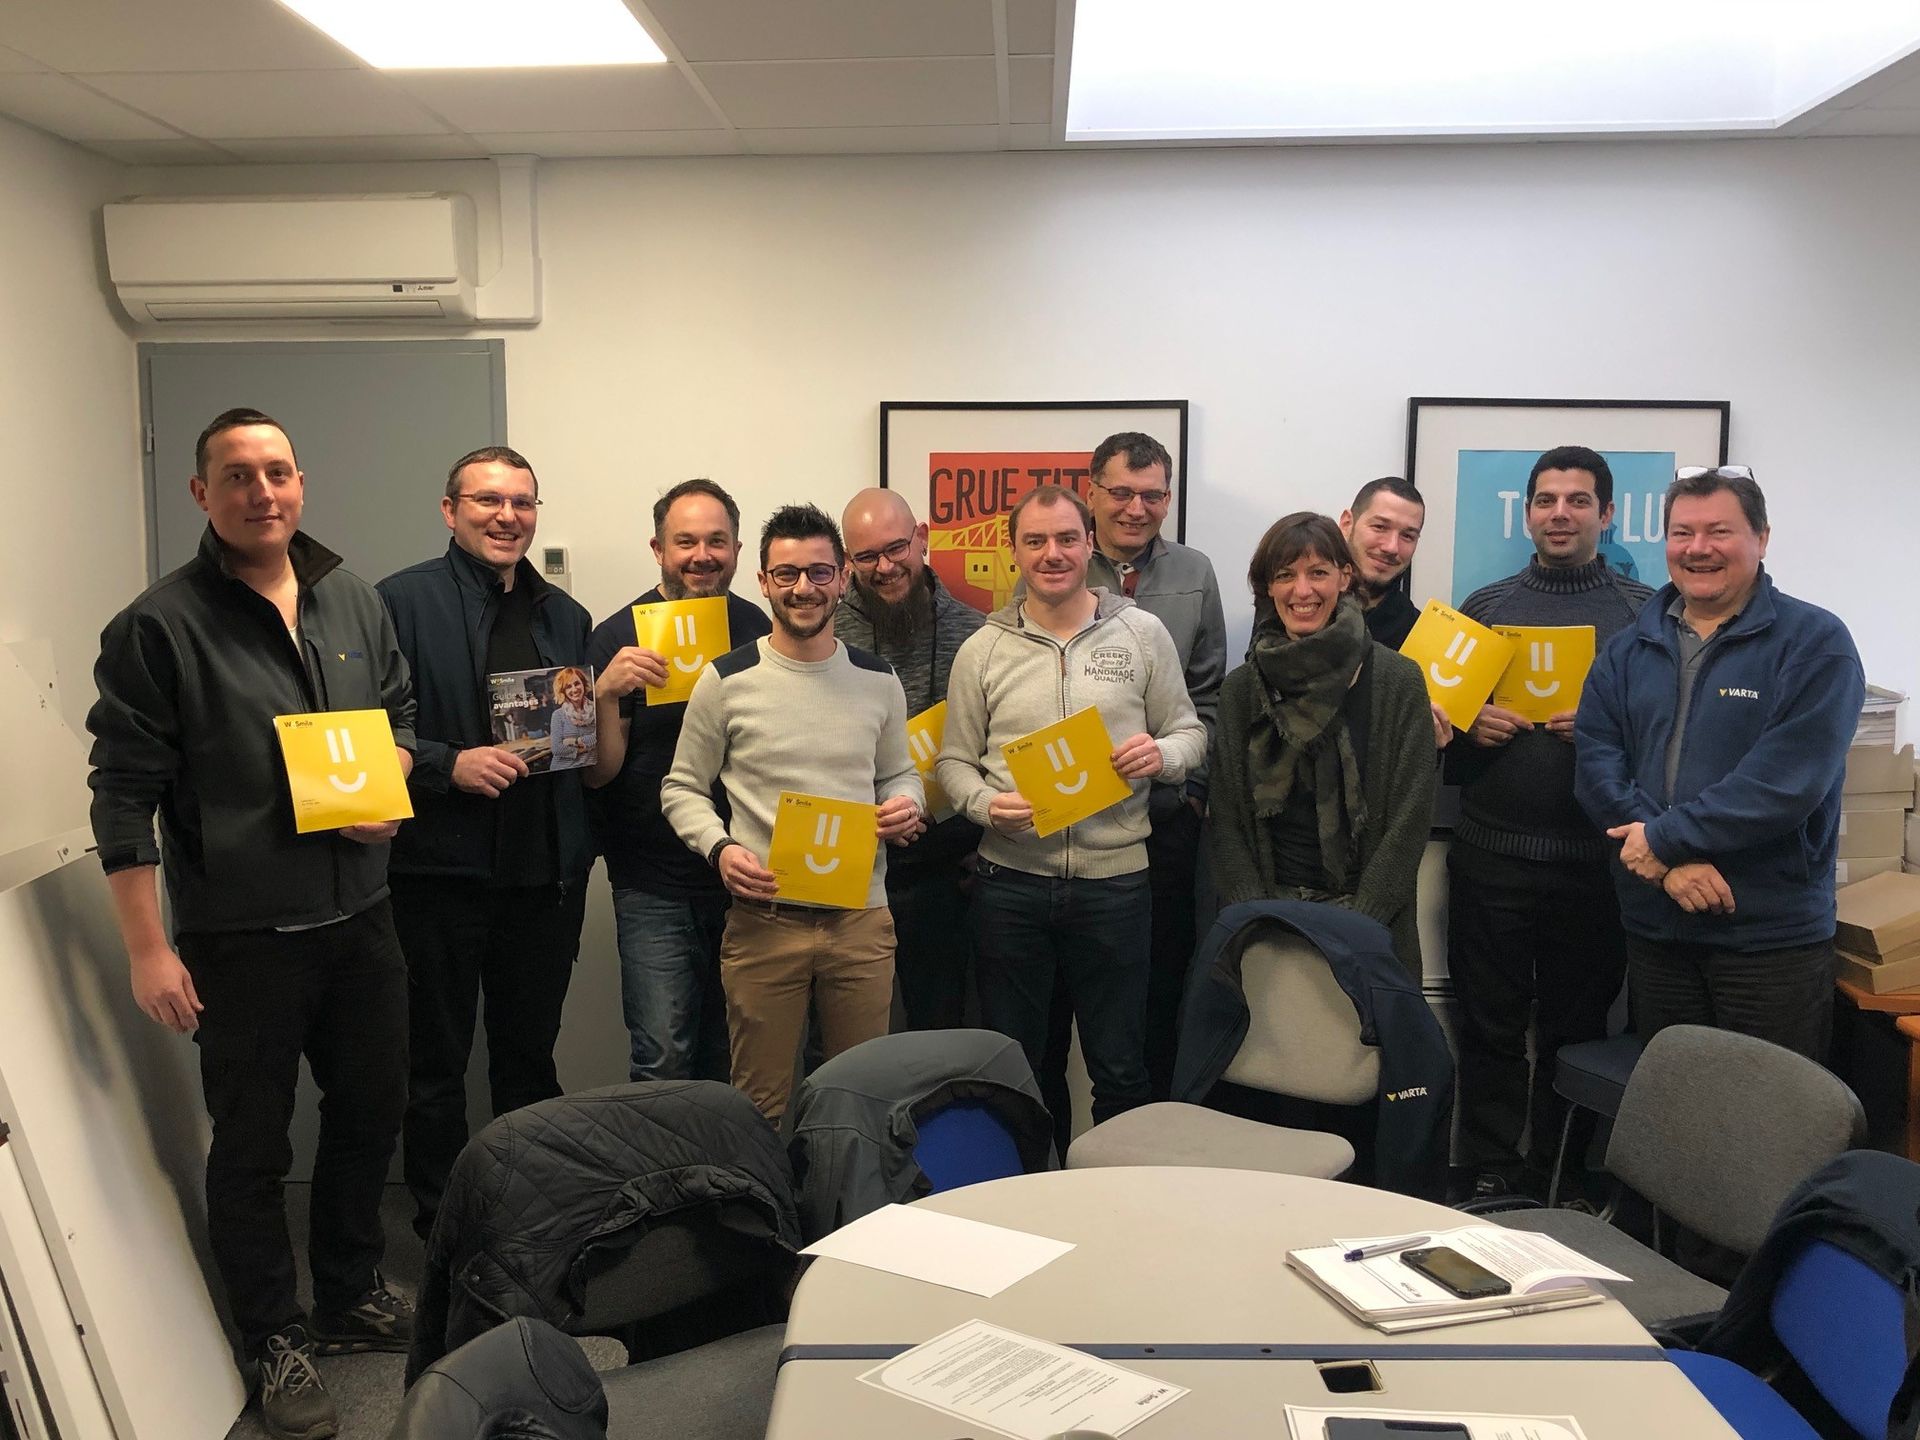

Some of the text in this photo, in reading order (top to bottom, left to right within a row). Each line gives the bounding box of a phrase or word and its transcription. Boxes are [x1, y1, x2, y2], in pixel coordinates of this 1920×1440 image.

[930, 468, 1019, 524] GRUE
[1623, 493, 1665, 543] LU
[1093, 652, 1130, 661] CREEKS
[1084, 664, 1135, 682] HANDMADE
[1093, 675, 1127, 685] QUALITY
[1728, 687, 1760, 700] VARTA
[493, 698, 539, 710] avantages
[1397, 1086, 1428, 1100] VARTA
